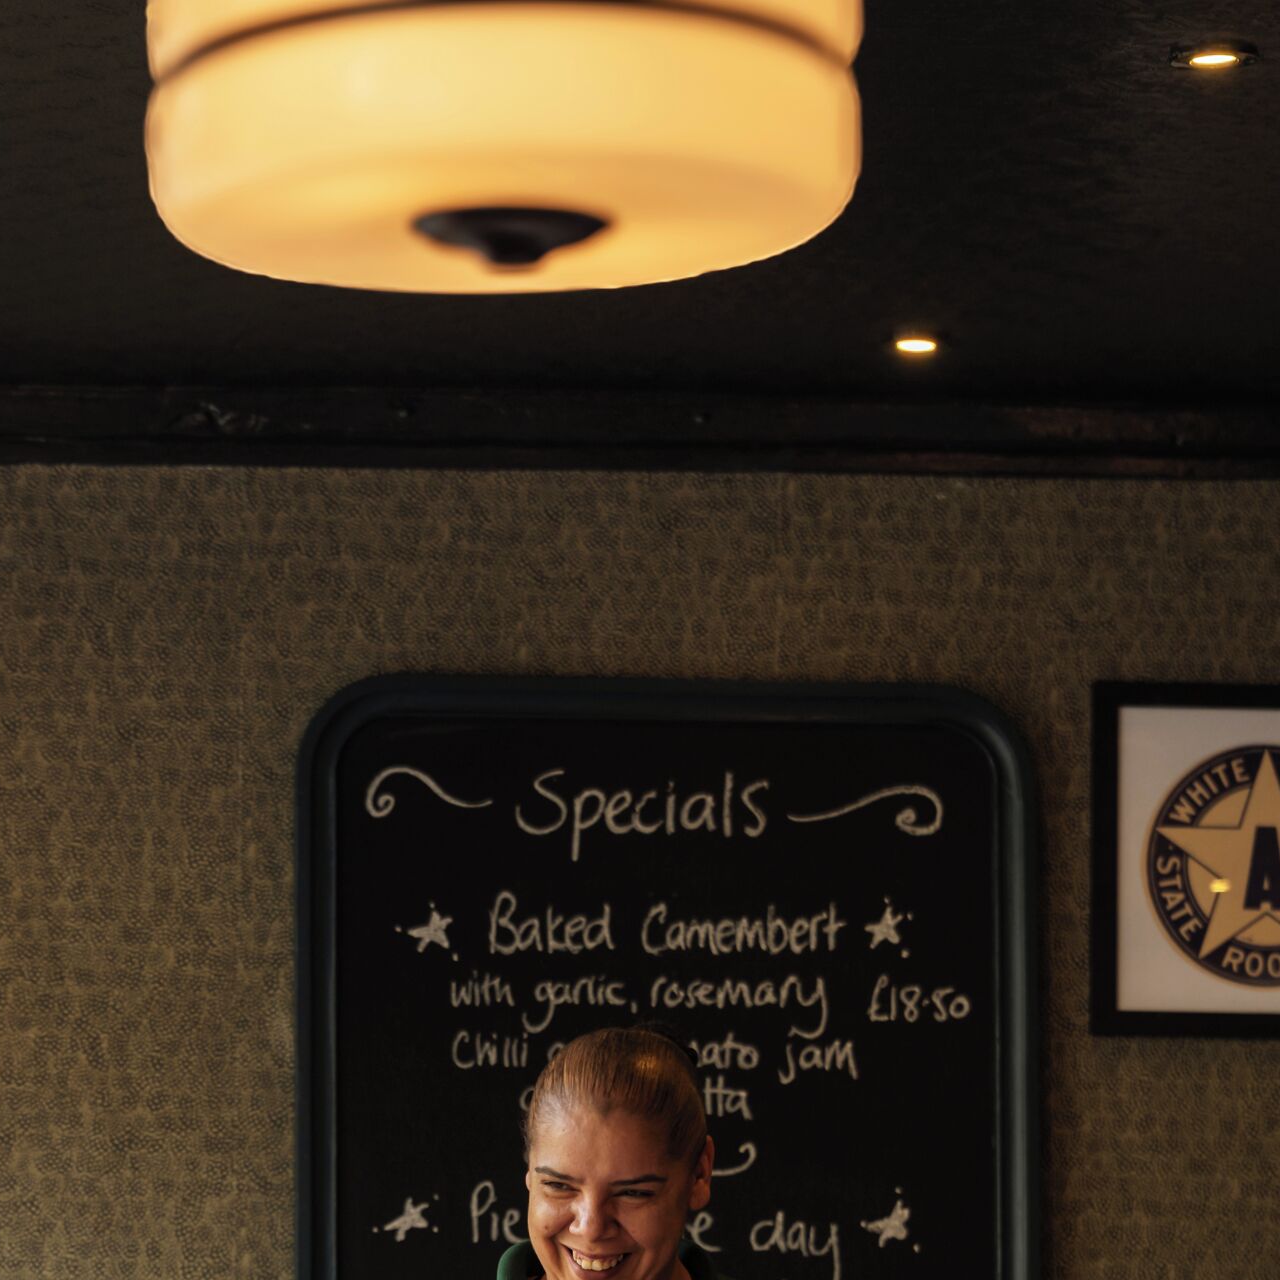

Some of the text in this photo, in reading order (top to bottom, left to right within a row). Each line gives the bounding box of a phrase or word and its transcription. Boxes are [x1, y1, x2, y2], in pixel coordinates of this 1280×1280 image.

[516, 770, 768, 861] Specials
[1169, 757, 1251, 825] WHITE
[489, 891, 845, 955] Baked Camembert
[1155, 855, 1202, 942] STATE
[450, 970, 515, 1008] with
[522, 974, 638, 1034] garlic,
[650, 975, 828, 1034] rosemary
[778, 1038, 858, 1085] jam
